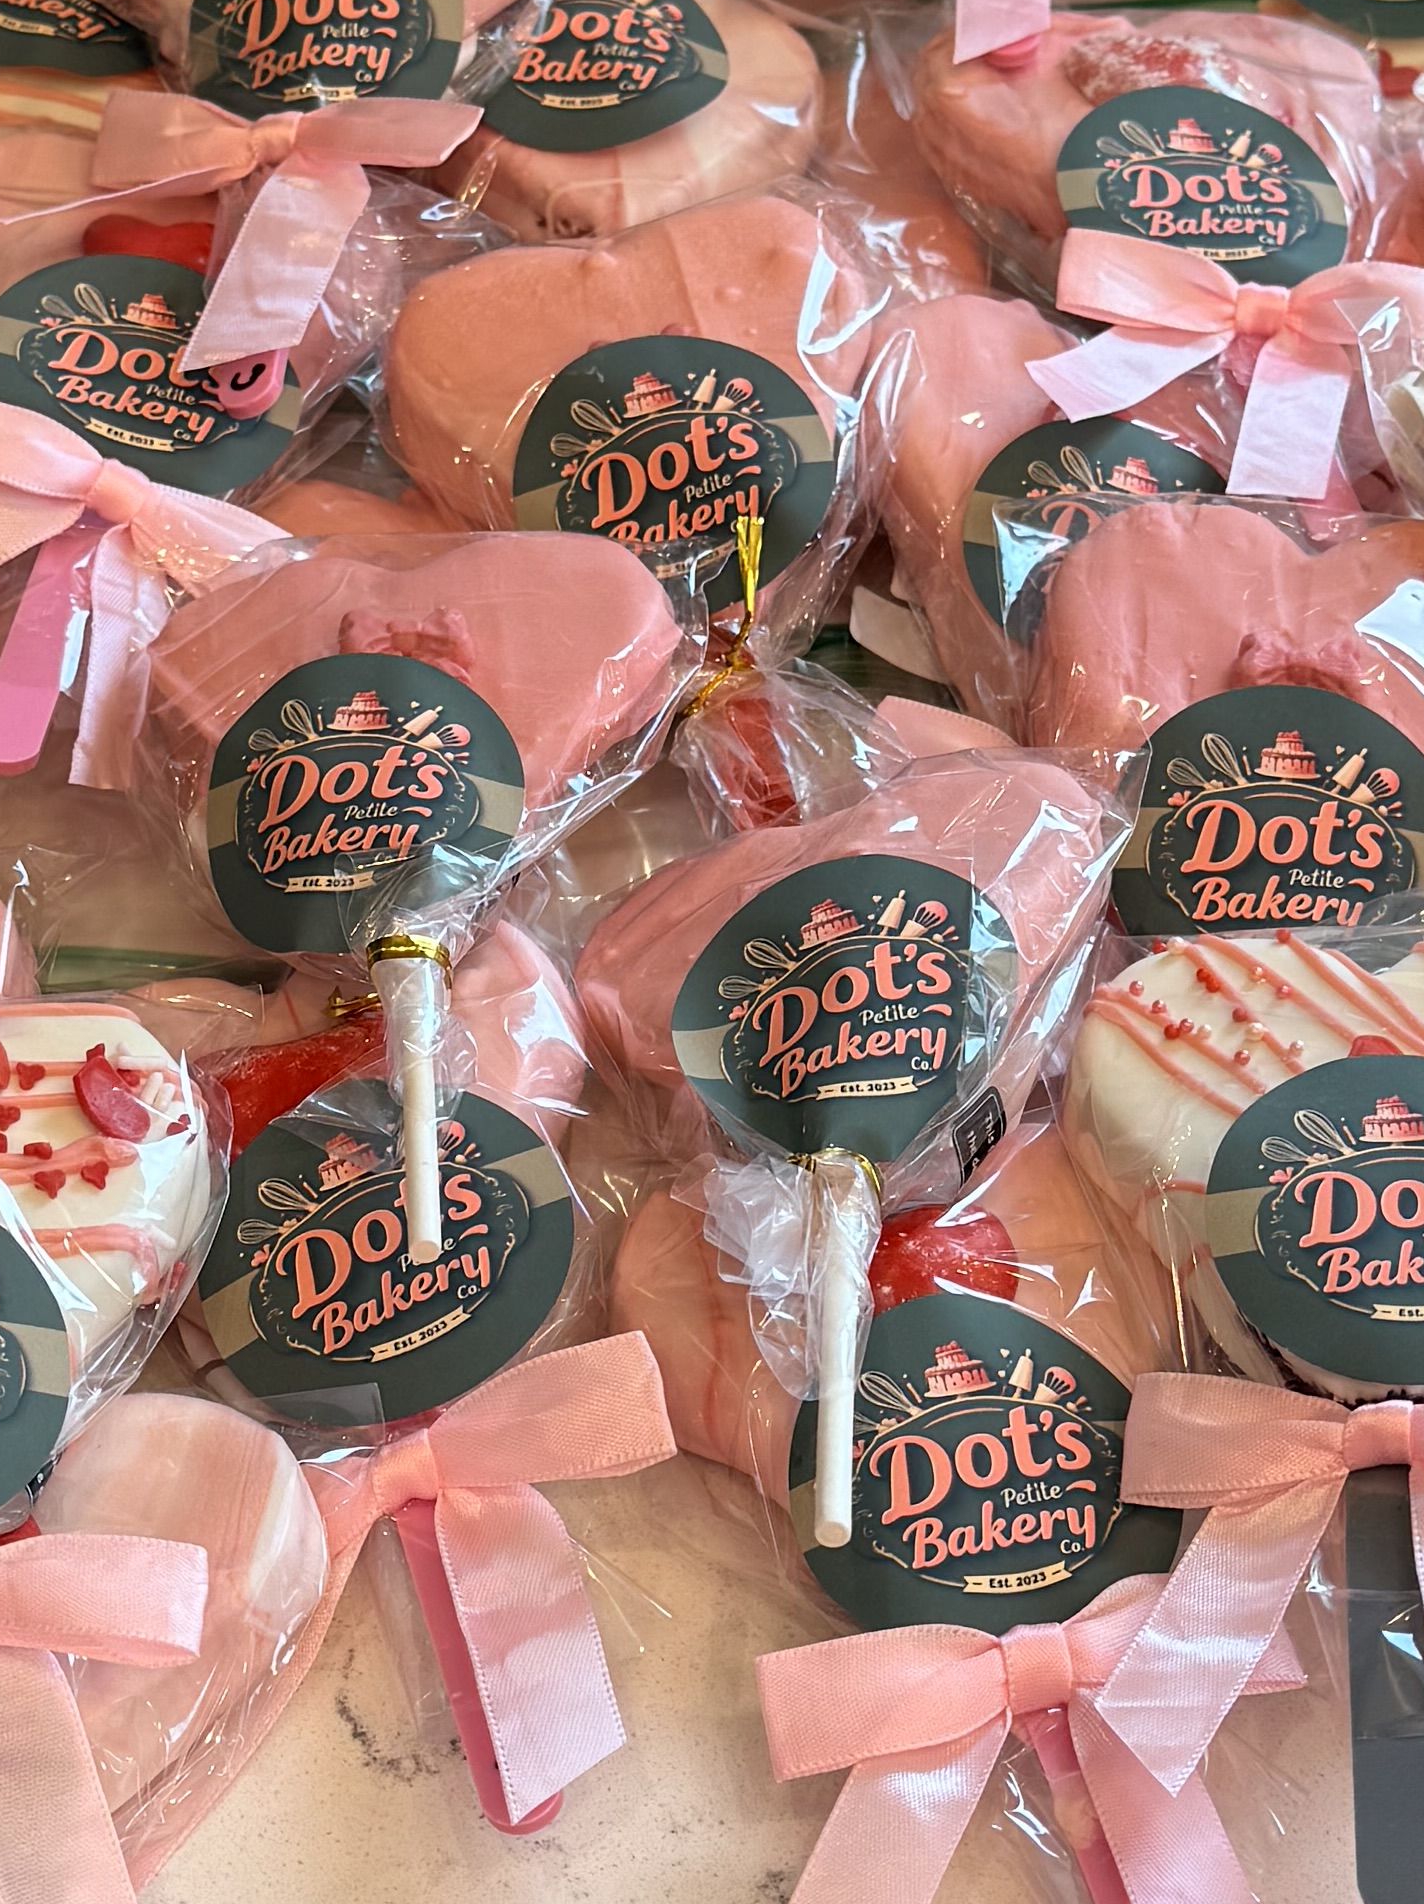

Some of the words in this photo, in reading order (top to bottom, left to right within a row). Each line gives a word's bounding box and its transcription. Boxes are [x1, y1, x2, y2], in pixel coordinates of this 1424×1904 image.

[252, 33, 392, 88] Bakery
[513, 48, 657, 90] Bakery
[1123, 164, 1287, 208] Dot's
[1144, 209, 1285, 246] Bakery
[56, 376, 215, 443] Bakery
[583, 415, 760, 529] Dot's
[258, 746, 446, 833] Dot's
[344, 803, 398, 821] Petite
[263, 816, 418, 873] Bakery
[1180, 800, 1384, 874] Dot's
[327, 875, 355, 889] 2023
[1289, 868, 1345, 888] Petite
[1192, 878, 1364, 926] Bakery
[752, 942, 952, 1065] Dot's
[859, 1004, 918, 1026] Petite
[773, 1015, 948, 1098] Bakery
[910, 1056, 933, 1072] Co.
[868, 1082, 896, 1093] 2023
[314, 1247, 492, 1353] Bakery
[456, 1283, 481, 1300] Co.
[418, 1320, 449, 1340] 2023
[870, 1405, 1092, 1527] Dot's
[1000, 1483, 1064, 1509] Petite
[902, 1498, 1098, 1570] Bakery
[1059, 1538, 1086, 1556] Co.
[1015, 1572, 1047, 1587] 2023
